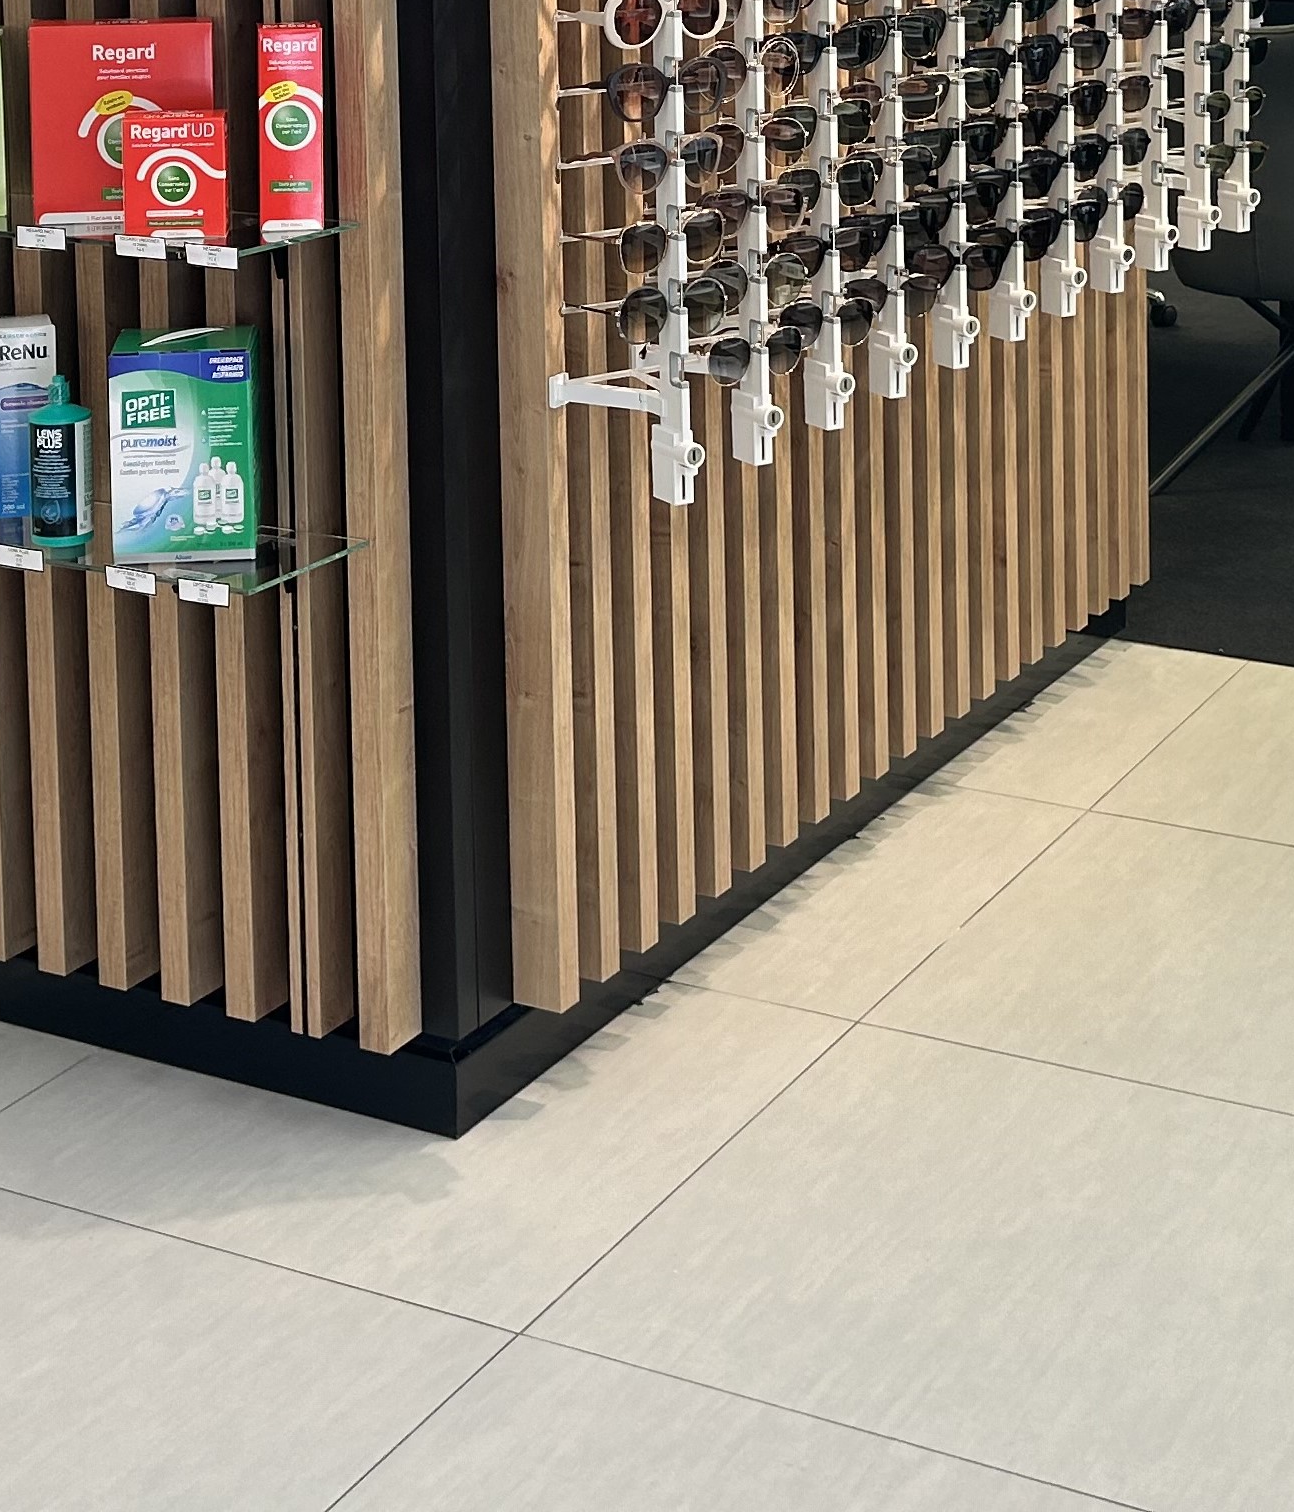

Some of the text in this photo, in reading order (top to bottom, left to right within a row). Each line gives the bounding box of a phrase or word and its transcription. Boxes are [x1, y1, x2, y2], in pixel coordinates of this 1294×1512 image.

[92, 43, 155, 63] Regard
[263, 37, 317, 56] Regard
[130, 122, 215, 142] Regard UD
[0, 343, 48, 361] ReNu
[125, 391, 170, 414] OPTI-
[126, 406, 172, 426] FREE
[36, 429, 63, 438] LENS
[36, 438, 63, 448] PLUS
[120, 435, 178, 451] puremoist
